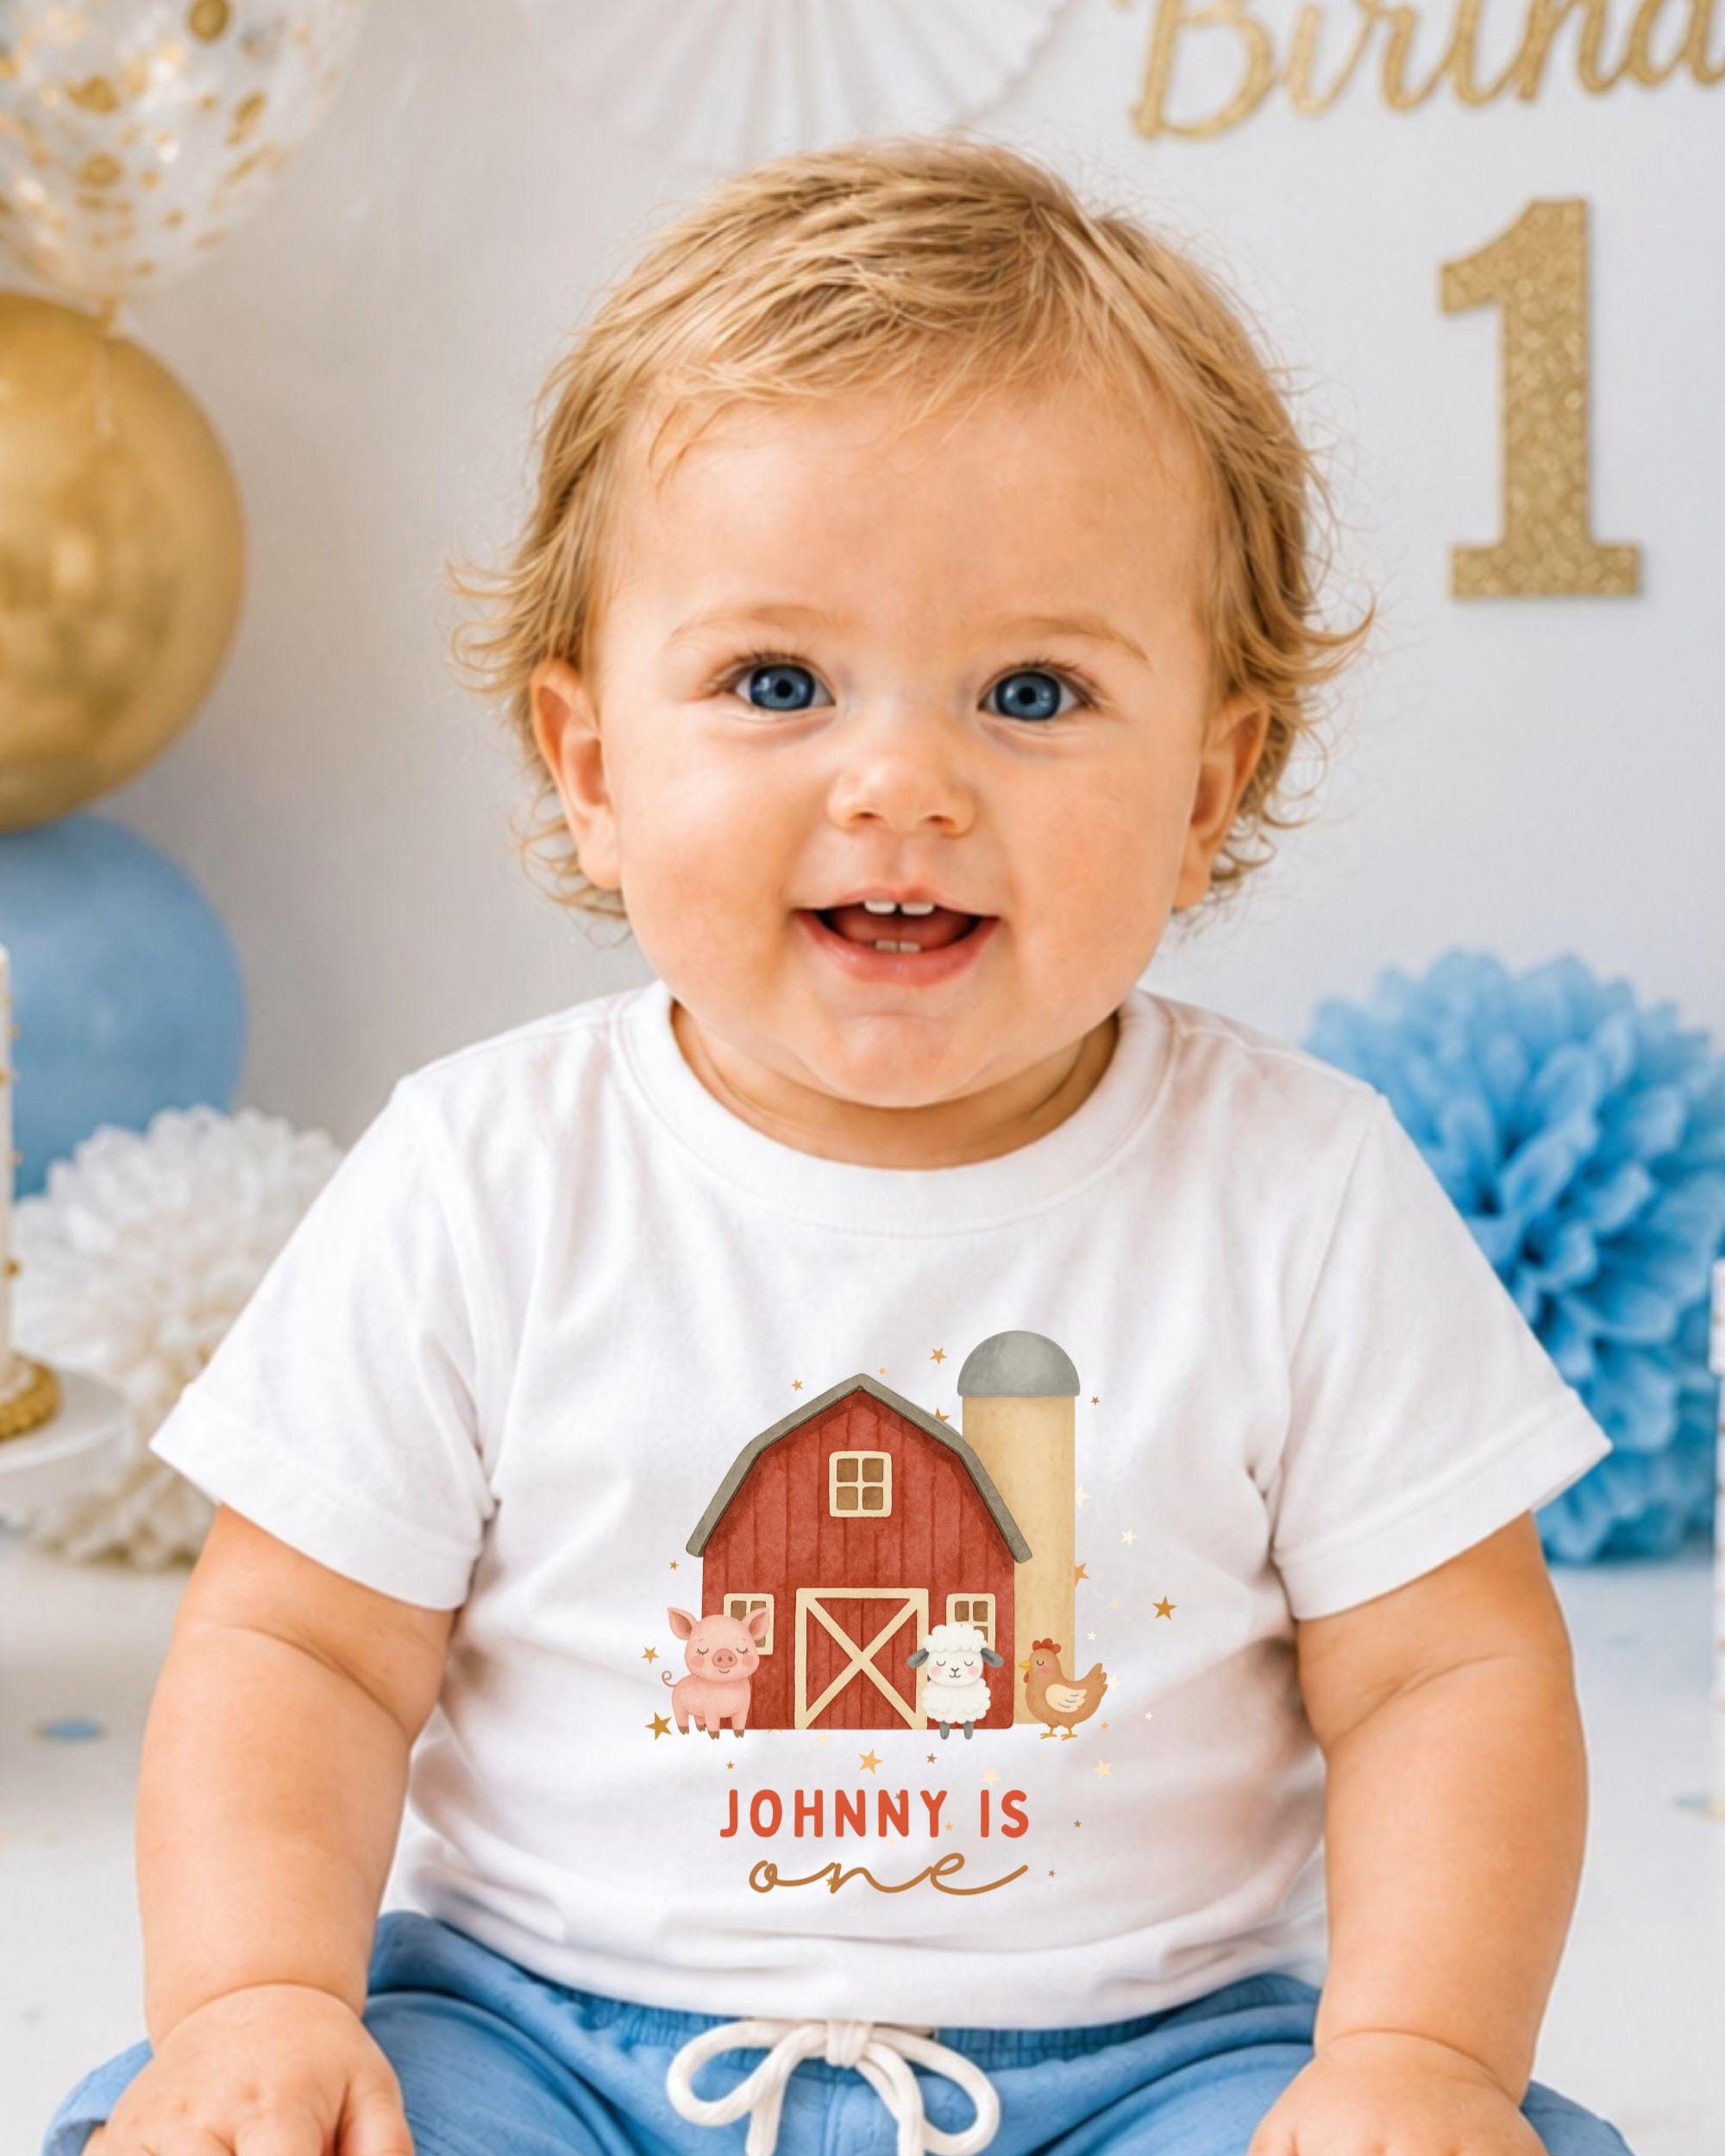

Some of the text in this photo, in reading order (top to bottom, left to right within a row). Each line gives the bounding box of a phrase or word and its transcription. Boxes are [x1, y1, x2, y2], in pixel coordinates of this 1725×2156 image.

[1439, 197, 1640, 601] 1
[719, 1789, 1030, 1839] JOHNNY IS
[748, 1852, 1029, 1896] one
